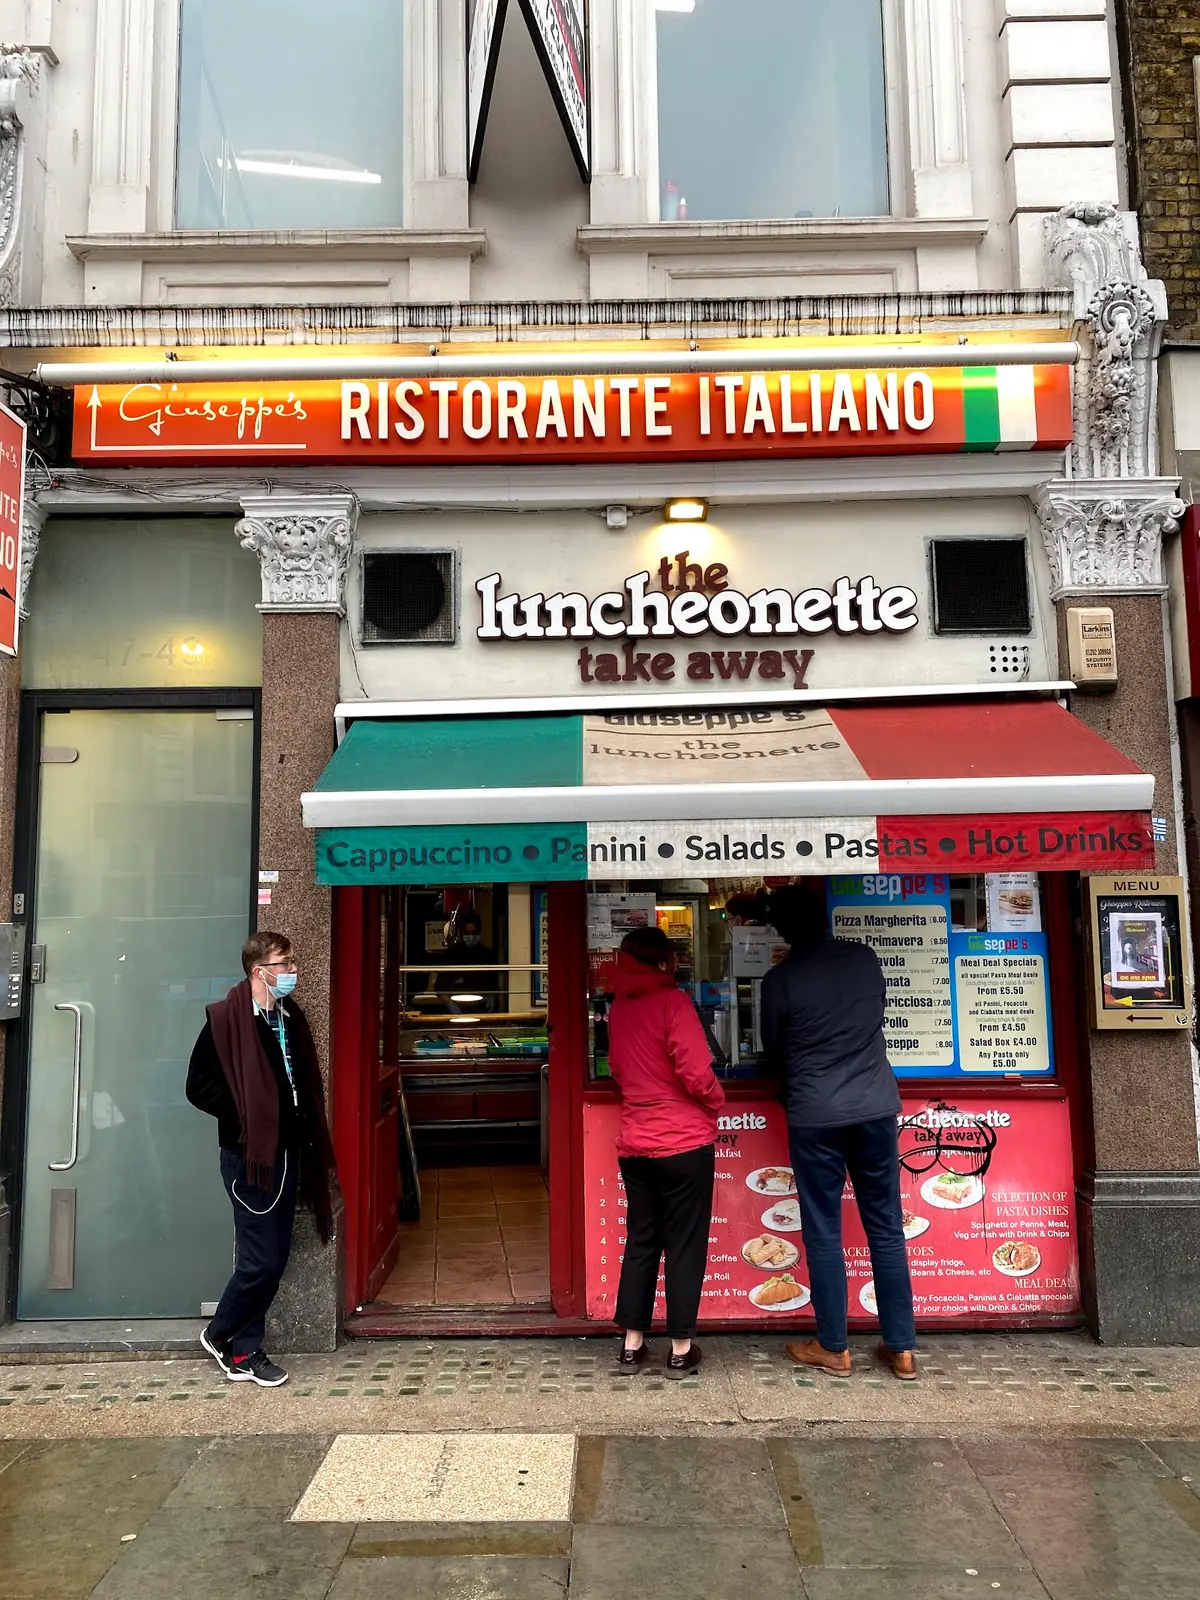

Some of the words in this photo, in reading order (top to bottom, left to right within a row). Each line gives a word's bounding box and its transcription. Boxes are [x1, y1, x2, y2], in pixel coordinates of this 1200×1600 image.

[119, 383, 307, 439] Giuseppe's
[340, 377, 673, 440] RISTORANTE
[700, 371, 934, 434] ITALIANO
[658, 550, 729, 591] the
[476, 571, 919, 641] luncheonette
[1083, 624, 1111, 633] Larkins
[578, 639, 675, 683] take
[687, 648, 814, 689] away
[590, 740, 841, 760] luncheonette
[682, 739, 741, 751] the
[326, 838, 512, 872] Cappuccino
[551, 836, 646, 864] Panini
[685, 833, 786, 862] Salads
[825, 833, 928, 859] Pastas
[968, 829, 1028, 856] Hot
[1038, 823, 1142, 853] Drinks
[1113, 881, 1160, 891] MENU
[835, 915, 861, 926] Pizza
[864, 914, 927, 928] Margherita
[865, 935, 924, 947] Primavera
[590, 954, 614, 962] UNDER
[877, 955, 906, 967] avola
[931, 957, 949, 965] £7.00
[960, 958, 980, 967] Meal
[982, 958, 1001, 967] Deal
[1003, 958, 1037, 968] Specials
[885, 976, 911, 987] nata
[932, 977, 950, 985] £7.00
[969, 972, 989, 980] special
[977, 987, 997, 995] from
[1000, 986, 1024, 995] £5.50
[885, 996, 933, 1008] ricciosa
[933, 998, 951, 1007] £7.00
[882, 1016, 909, 1028] Pollo
[934, 1018, 952, 1026] £7.50
[979, 1023, 999, 1032] from
[1002, 1023, 1026, 1031] £4.50
[885, 1038, 920, 1051] seppe
[935, 1040, 953, 1048] £8.00
[969, 1038, 993, 1047] Salad
[995, 1038, 1010, 1046] Box
[1013, 1037, 1037, 1046] £4.00
[978, 1051, 991, 1060] Any
[993, 1051, 1013, 1059] Pasta
[1014, 1050, 1030, 1060] only
[992, 1059, 1017, 1068] £5.00
[946, 1131, 981, 1144] away
[714, 1148, 742, 1158] akfast
[714, 1170, 734, 1180] hips,
[600, 1177, 604, 1186] 1
[599, 1198, 606, 1207] 2
[991, 1191, 1051, 1203] SELECTION
[1052, 1191, 1067, 1201] OF
[996, 1206, 1030, 1217] PASTA
[1031, 1205, 1069, 1216] DISHES
[600, 1217, 606, 1226] 3
[711, 1215, 728, 1224] ffee
[971, 1221, 1009, 1230] Spaghetti
[1020, 1220, 1047, 1229] Penne,
[1048, 1220, 1070, 1229] Meat,
[600, 1236, 607, 1245] 4
[953, 1231, 969, 1240] Veg
[980, 1231, 997, 1239] Fish
[998, 1231, 1015, 1239] with
[1047, 1230, 1070, 1239] Chips
[843, 1246, 870, 1257] ACKE
[905, 1246, 935, 1257] TOES
[600, 1255, 607, 1265] 5
[709, 1254, 738, 1263] Coffee
[911, 1259, 938, 1268] display
[939, 1258, 966, 1268] fridge,
[600, 1274, 607, 1283] 6
[714, 1272, 730, 1281] Roll
[911, 1269, 936, 1277] Beans
[937, 1268, 944, 1276] &
[945, 1268, 977, 1277] Cheese,
[978, 1268, 991, 1276] etc
[1014, 1278, 1044, 1289] MEAL
[601, 1293, 607, 1302] 7
[700, 1288, 722, 1297] ssant
[723, 1288, 730, 1297] &
[731, 1288, 748, 1297] Tea
[912, 1295, 927, 1304] Any
[929, 1294, 967, 1304] Focaccia,
[968, 1293, 997, 1302] Paninis
[998, 1293, 1004, 1301] &
[1006, 1293, 1039, 1301] Ciabatta
[1041, 1292, 1073, 1302] specials
[912, 1304, 921, 1312] of
[922, 1305, 941, 1313] your
[941, 1304, 969, 1312] choice
[969, 1303, 987, 1312] with
[988, 1303, 1009, 1311] Drink
[1011, 1303, 1018, 1311] &
[1018, 1303, 1041, 1312] Chips
